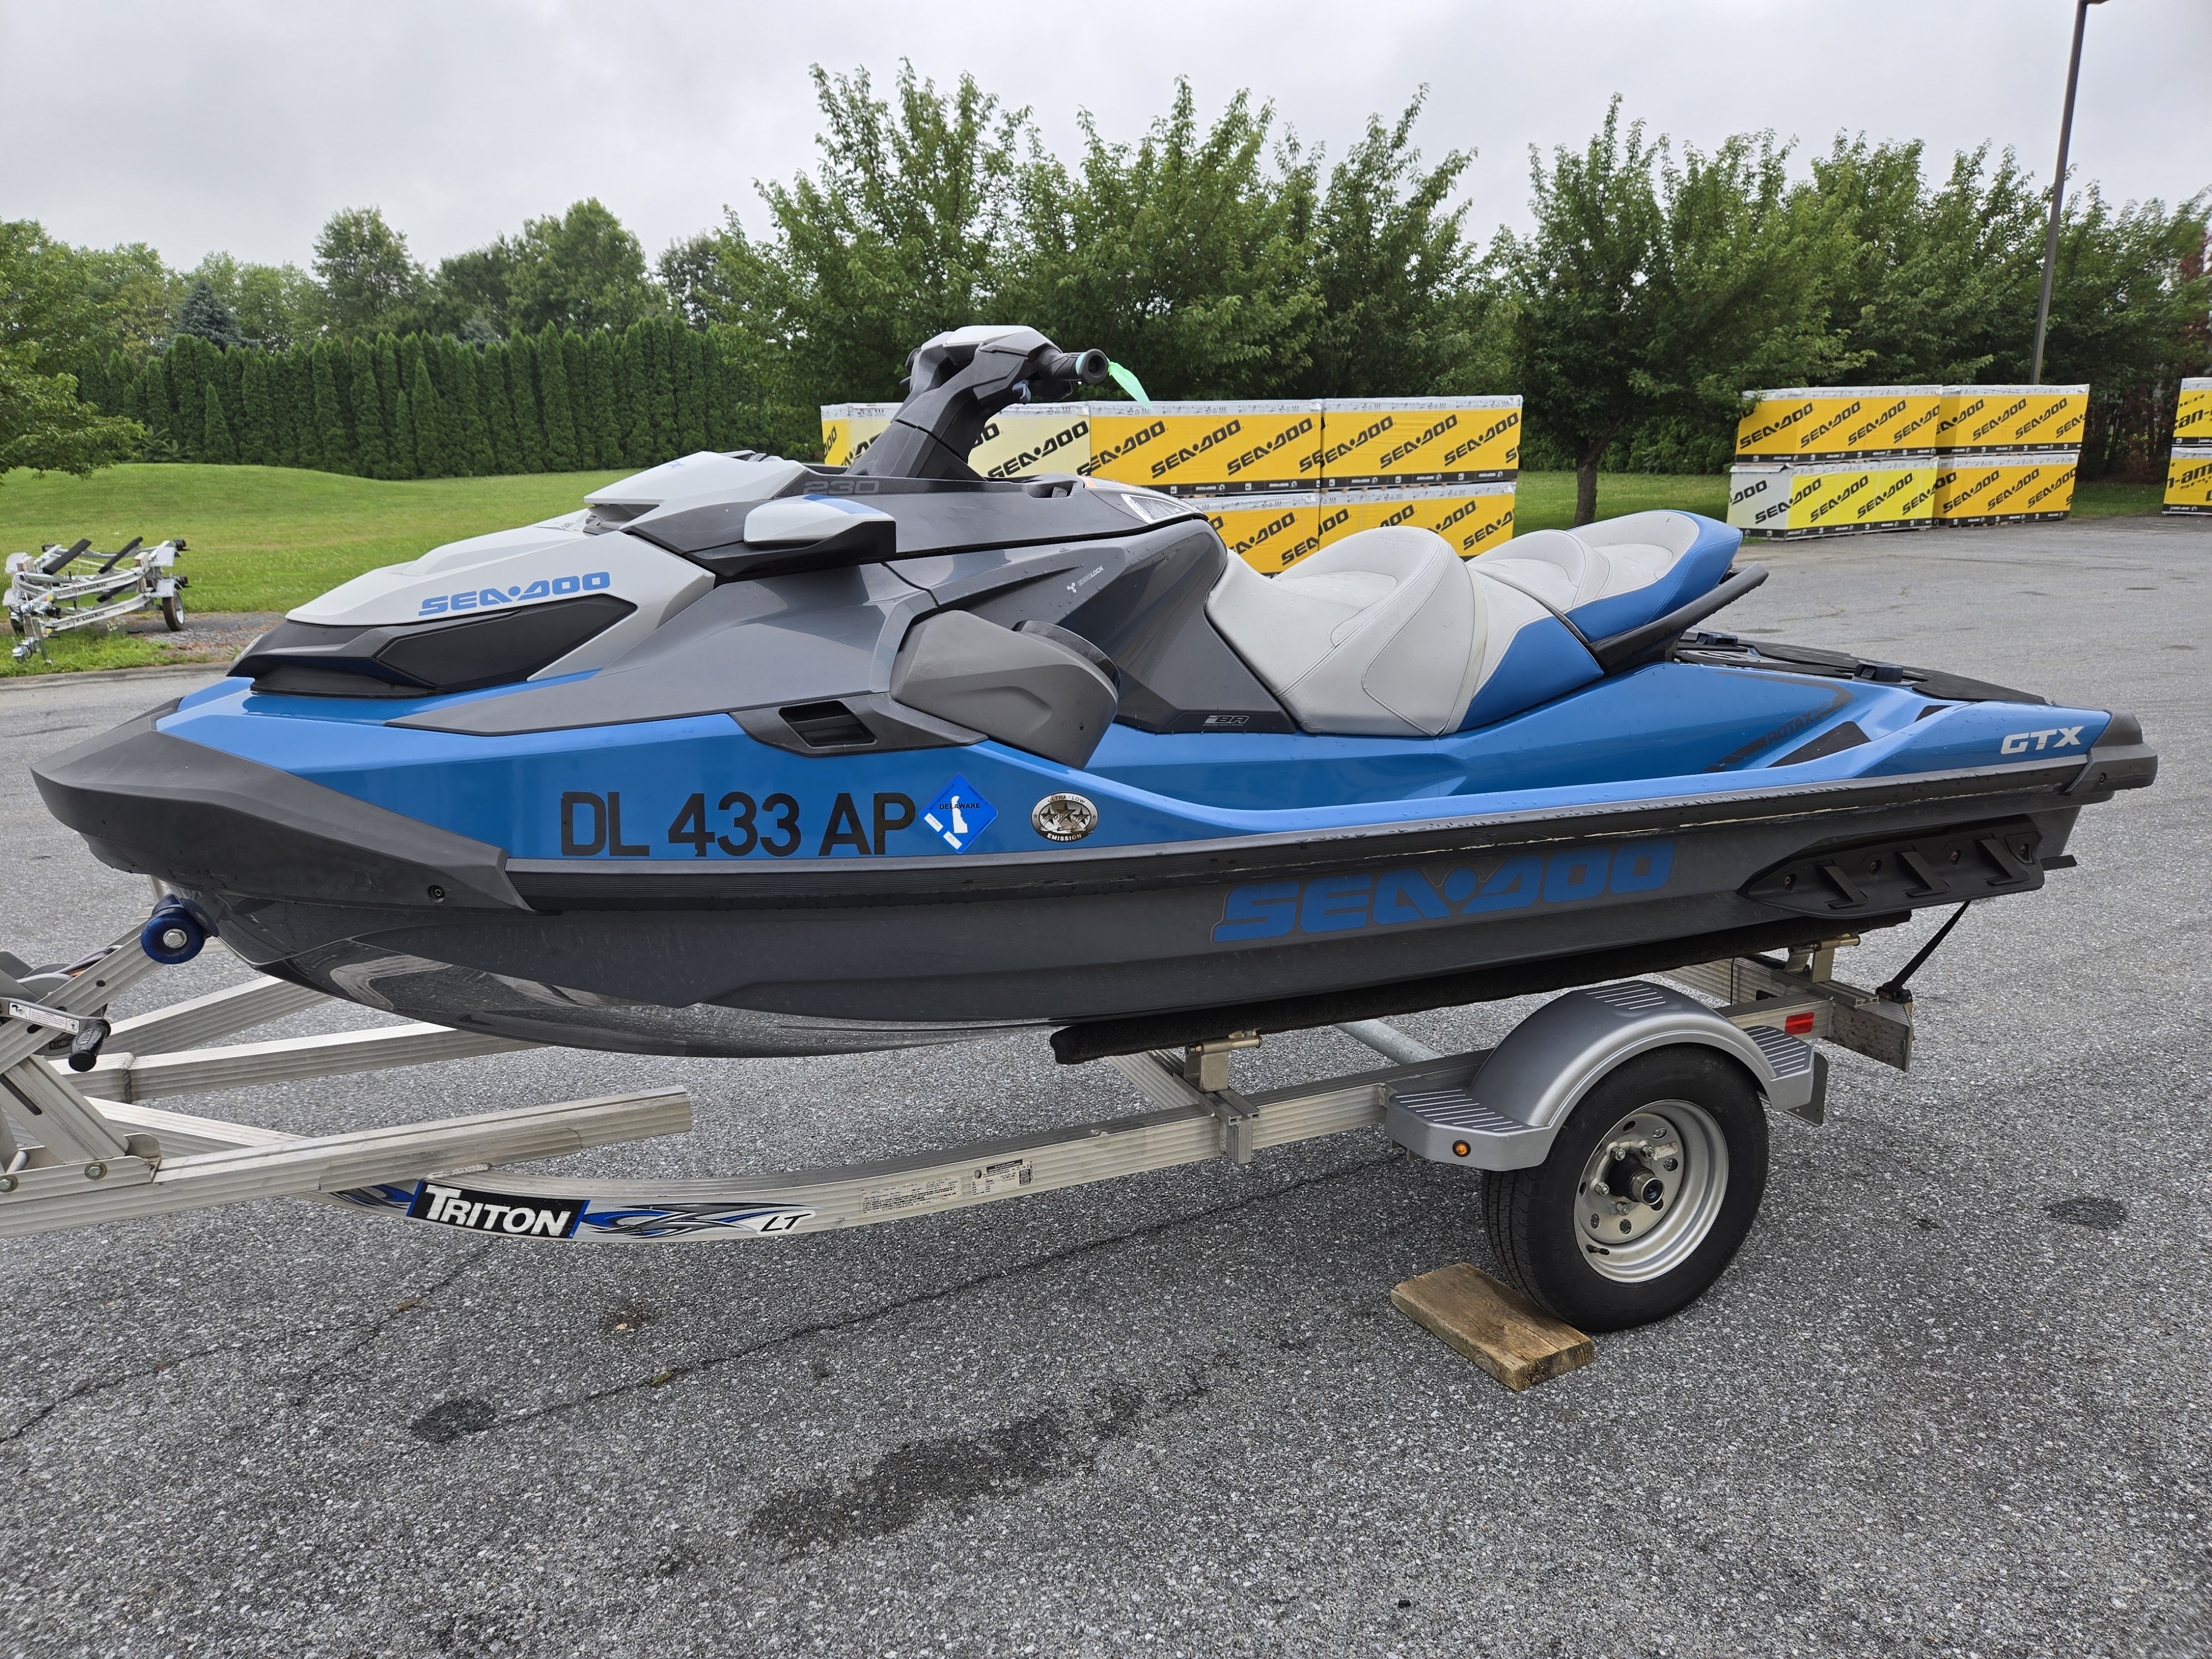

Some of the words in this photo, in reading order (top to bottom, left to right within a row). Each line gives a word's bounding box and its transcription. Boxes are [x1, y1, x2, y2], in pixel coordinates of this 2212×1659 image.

[803, 480, 879, 494] 230
[1767, 710, 1815, 745] ROTAX
[2000, 726, 2084, 755] GTX
[561, 791, 650, 857] DL
[668, 791, 801, 857] 433
[818, 792, 916, 857] AP
[1047, 833, 1082, 841] EMISSION
[425, 1185, 571, 1237] TRITON
[760, 1213, 812, 1232] LT
